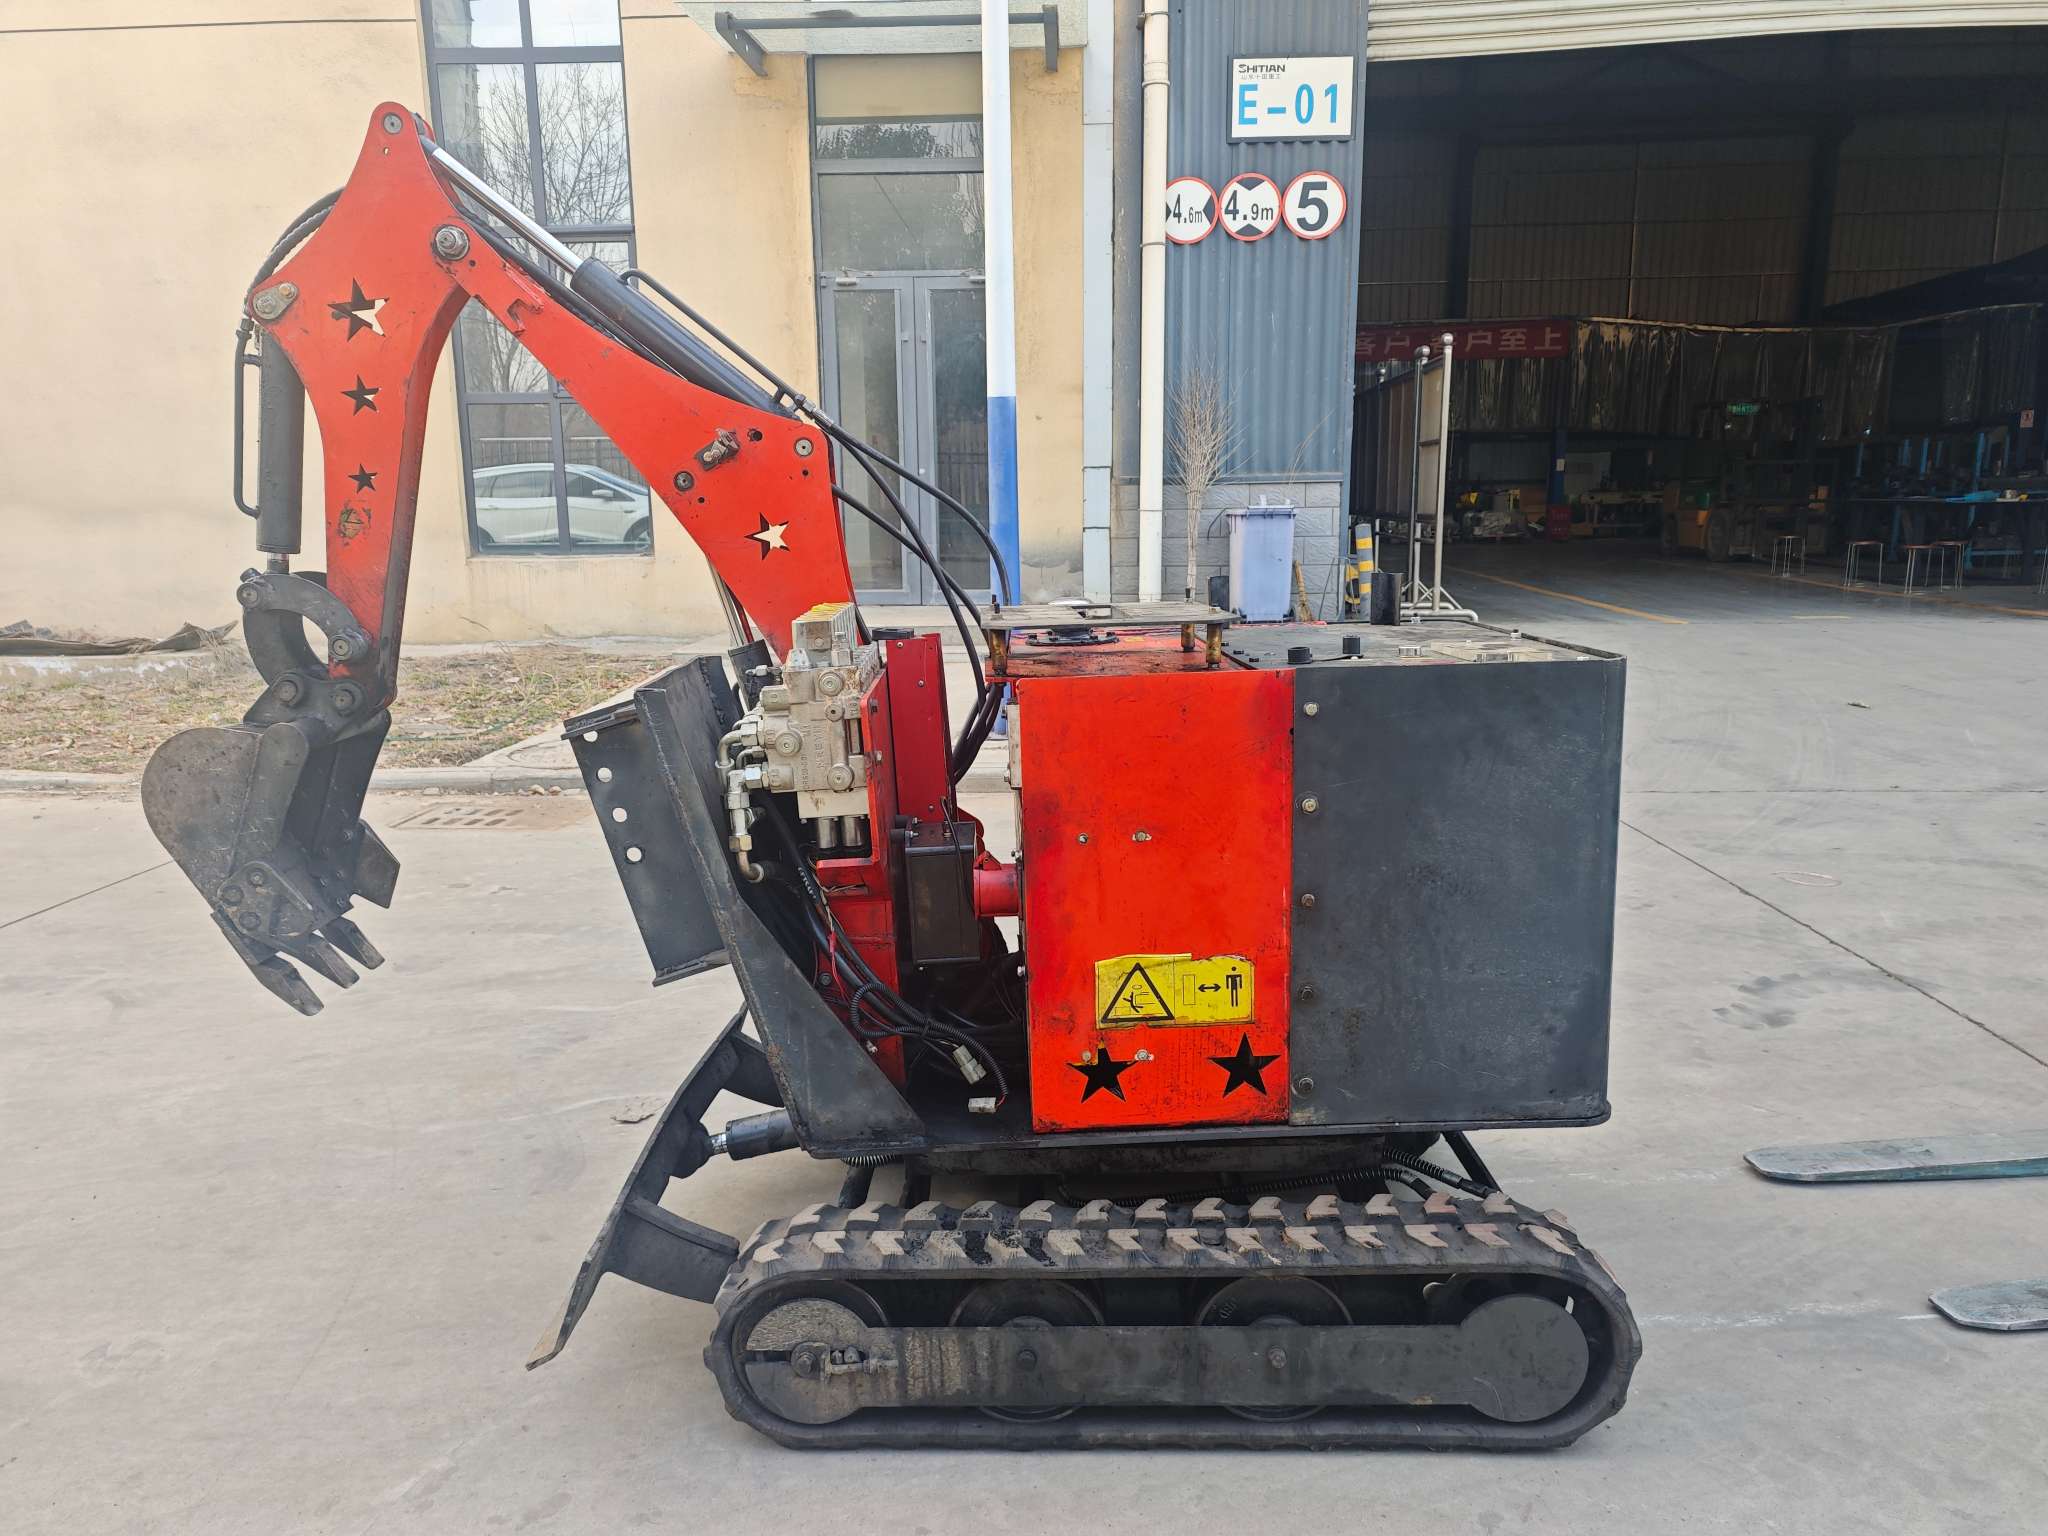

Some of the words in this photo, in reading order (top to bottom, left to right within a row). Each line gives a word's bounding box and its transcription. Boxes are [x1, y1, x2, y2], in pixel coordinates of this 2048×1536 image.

[1238, 64, 1286, 73] SHITIAN
[1238, 83, 1338, 124] E-01
[1172, 193, 1203, 224] 4.6m
[1224, 189, 1274, 221] 4.9m
[1296, 181, 1329, 232] 5
